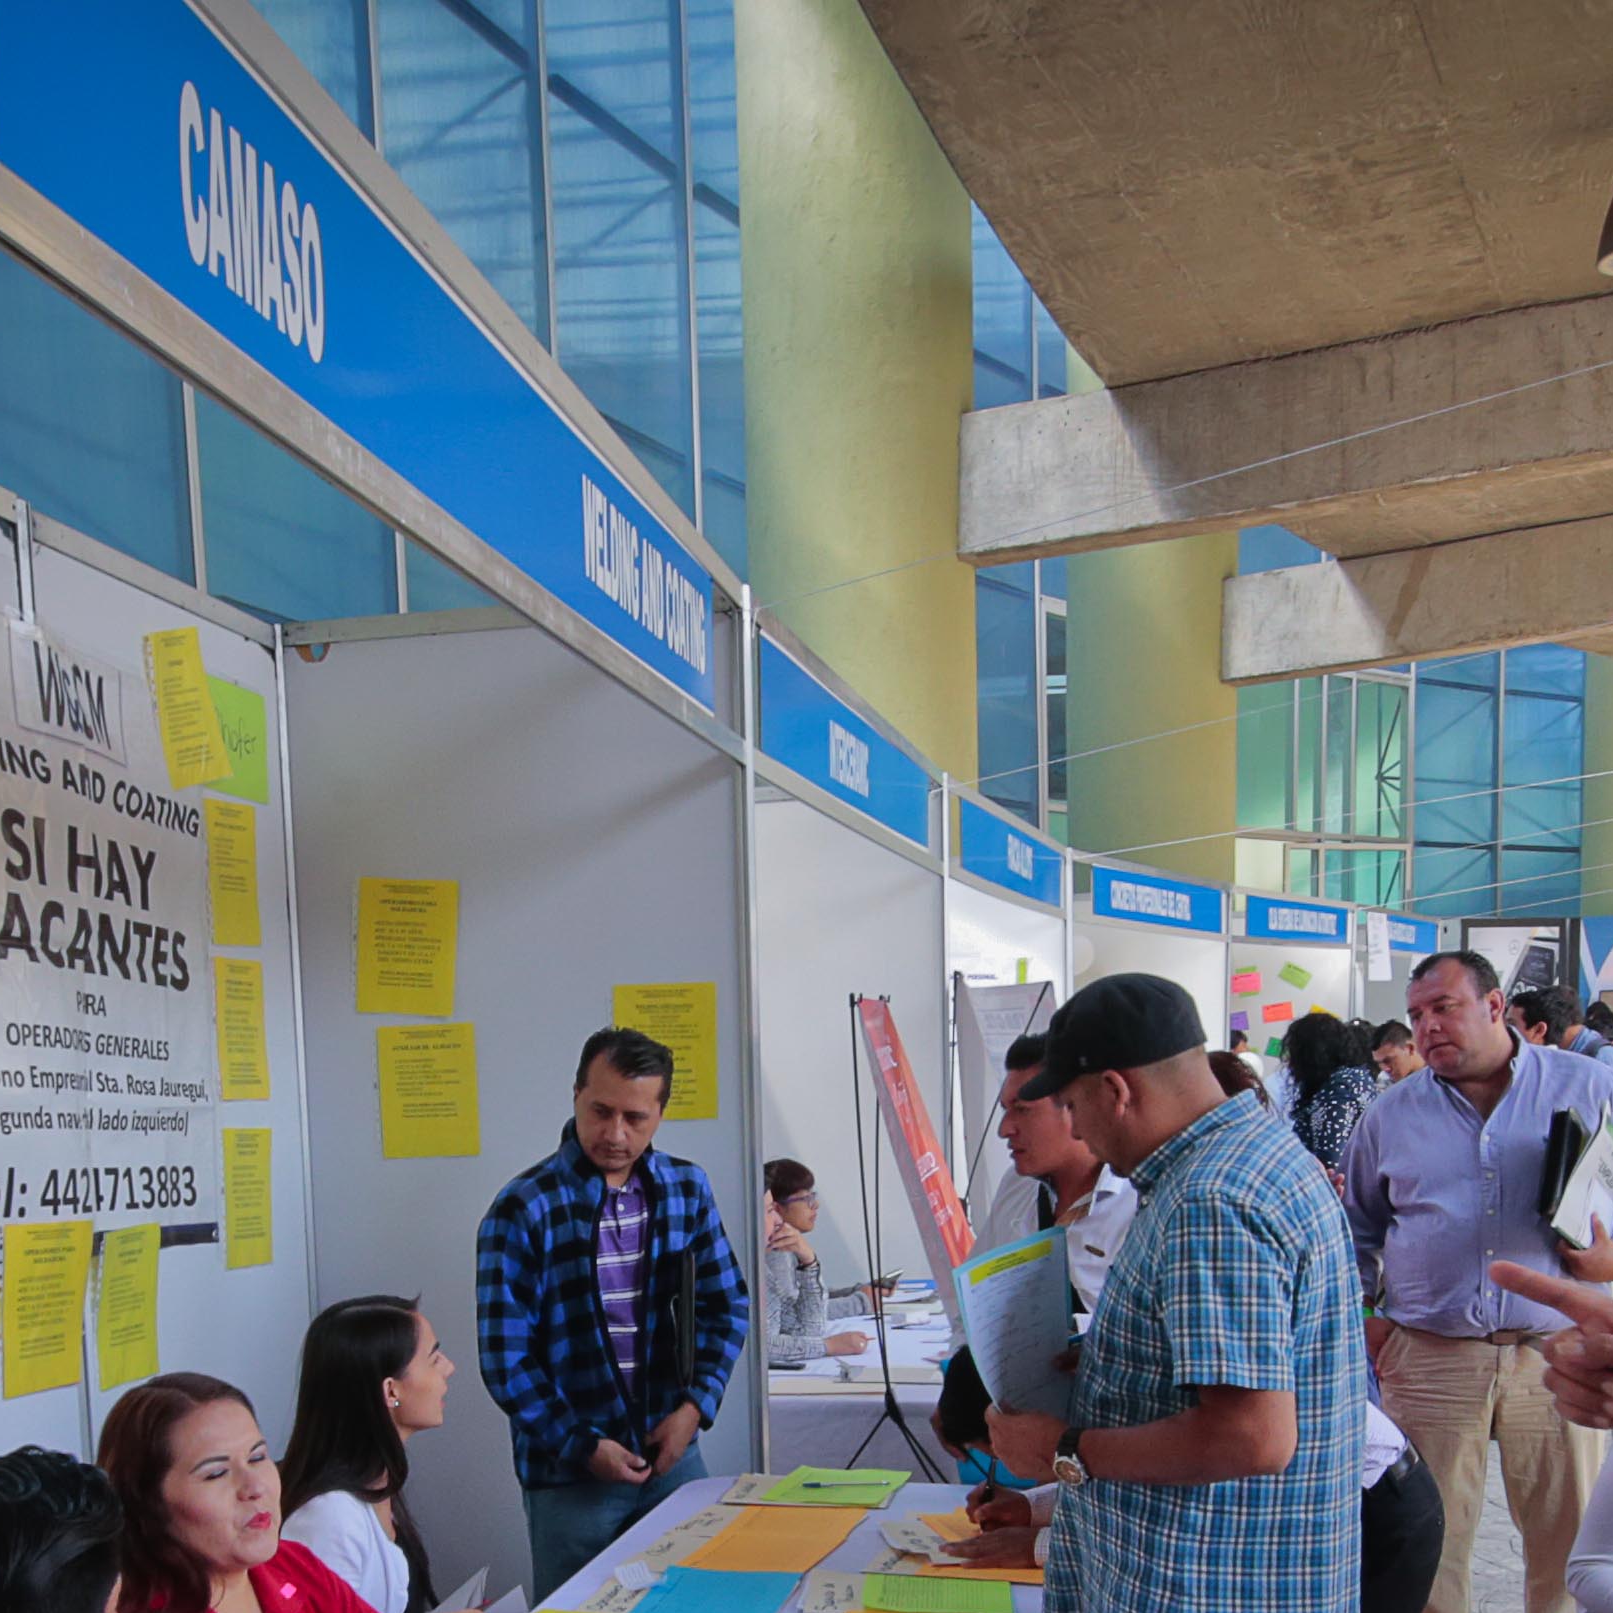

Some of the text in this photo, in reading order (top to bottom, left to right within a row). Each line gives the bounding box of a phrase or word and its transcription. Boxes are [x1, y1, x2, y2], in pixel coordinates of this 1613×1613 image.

[180, 80, 325, 364] CAMASO
[582, 473, 705, 675] WELDING AND COATING
[113, 780, 200, 837] COATING
[1, 807, 47, 886] SI
[68, 825, 156, 911] HAY
[95, 1033, 169, 1061] GENERALES
[96, 1071, 123, 1094] Sta.
[126, 1074, 156, 1096] Rosa
[98, 1108, 128, 1131] lado
[131, 1111, 189, 1136] izquierdo)
